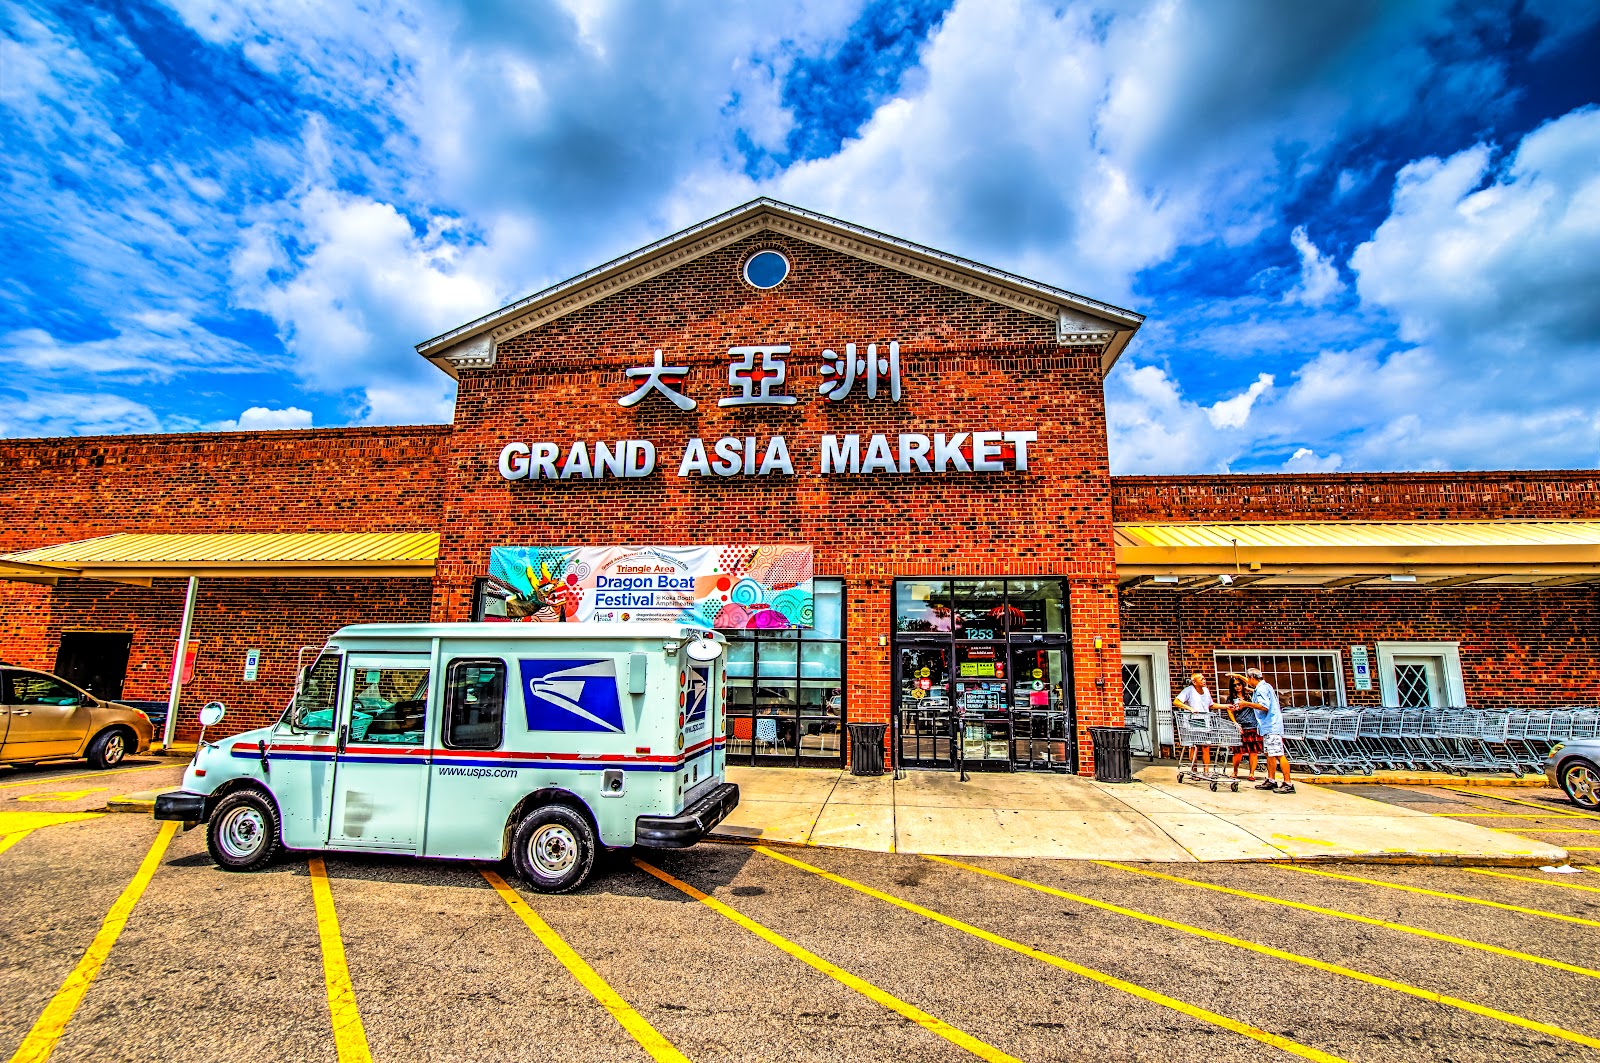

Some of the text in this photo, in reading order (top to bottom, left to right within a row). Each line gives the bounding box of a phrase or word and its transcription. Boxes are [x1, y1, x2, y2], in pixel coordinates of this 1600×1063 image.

[617, 340, 901, 411] 大亞洲
[499, 430, 1038, 481] GRAND ASIA MARKET
[616, 564, 675, 574] Triangle Area
[596, 575, 695, 591] Dragon Boat
[595, 592, 654, 606] Festival
[965, 629, 994, 640] 1253
[438, 767, 518, 779] www.usps.com
